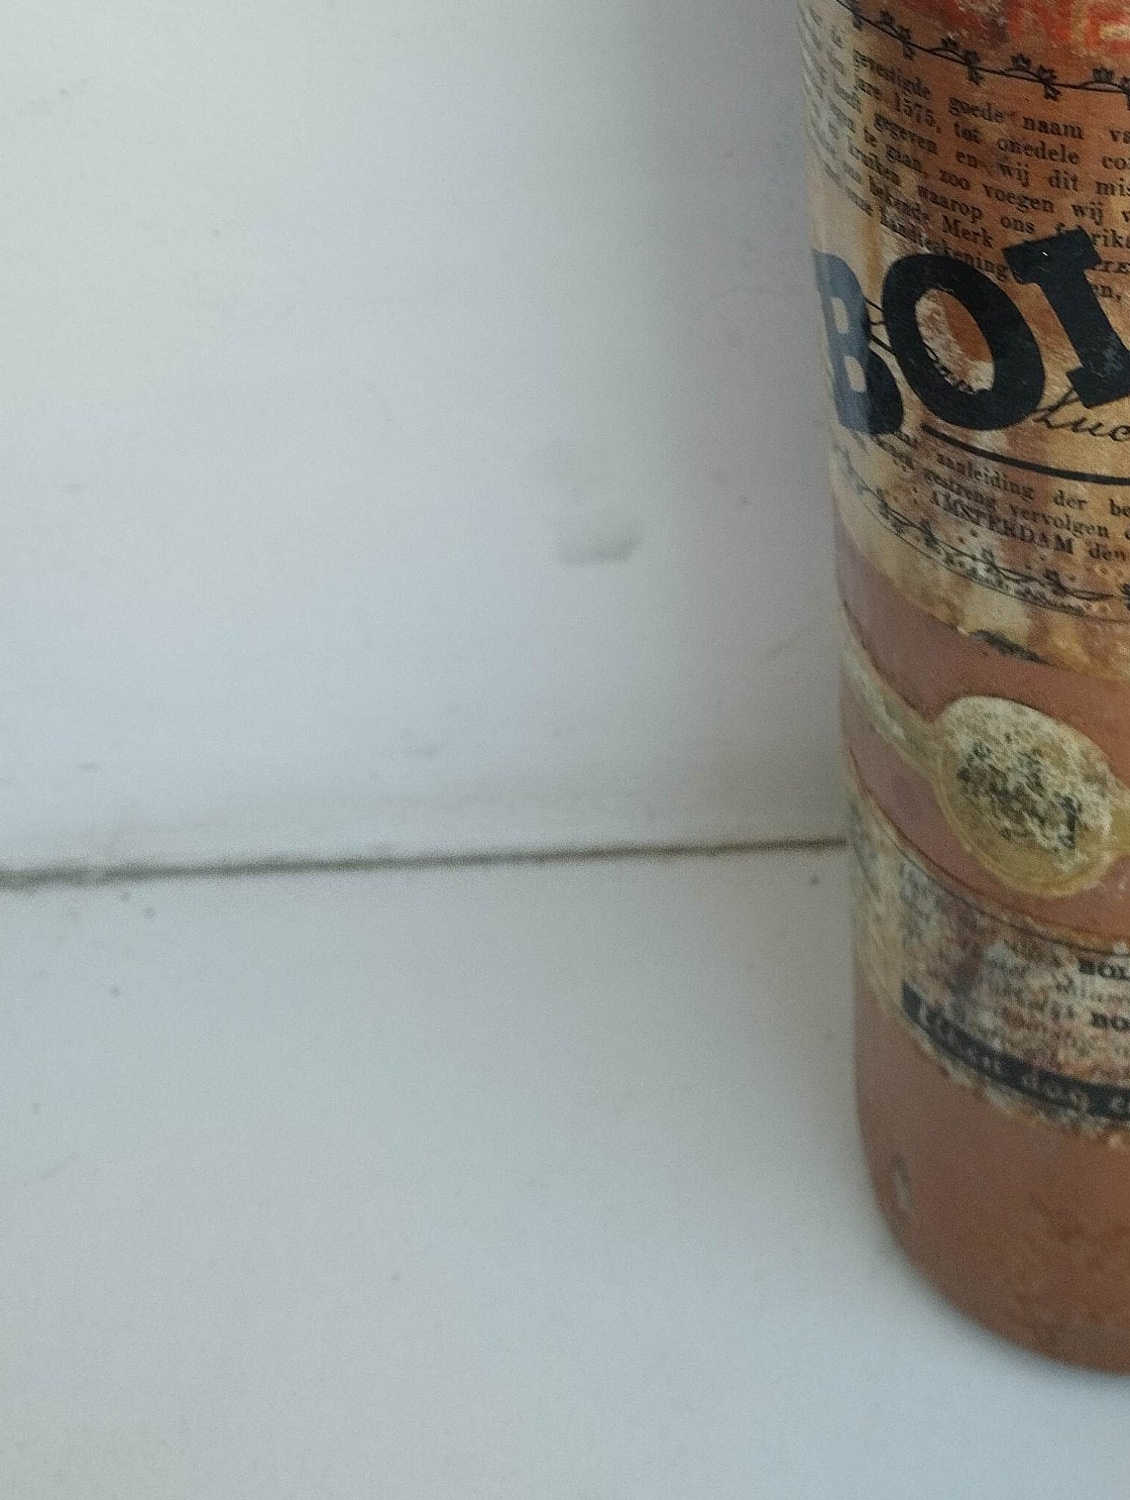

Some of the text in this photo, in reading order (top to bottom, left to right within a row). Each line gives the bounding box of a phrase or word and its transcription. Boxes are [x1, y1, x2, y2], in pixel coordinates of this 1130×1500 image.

[947, 97, 1004, 124] goede
[1022, 115, 1084, 140] naam
[955, 150, 979, 168] en
[998, 158, 1030, 188] wij
[1049, 168, 1080, 192] dit
[939, 168, 971, 192] zoo
[981, 182, 1055, 214] voegen
[1071, 200, 1103, 227] wij
[942, 214, 994, 249] Merk
[1000, 215, 1036, 235] ons
[1053, 489, 1088, 510] der
[1009, 503, 1109, 537] vervolgen
[1088, 539, 1126, 562] den
